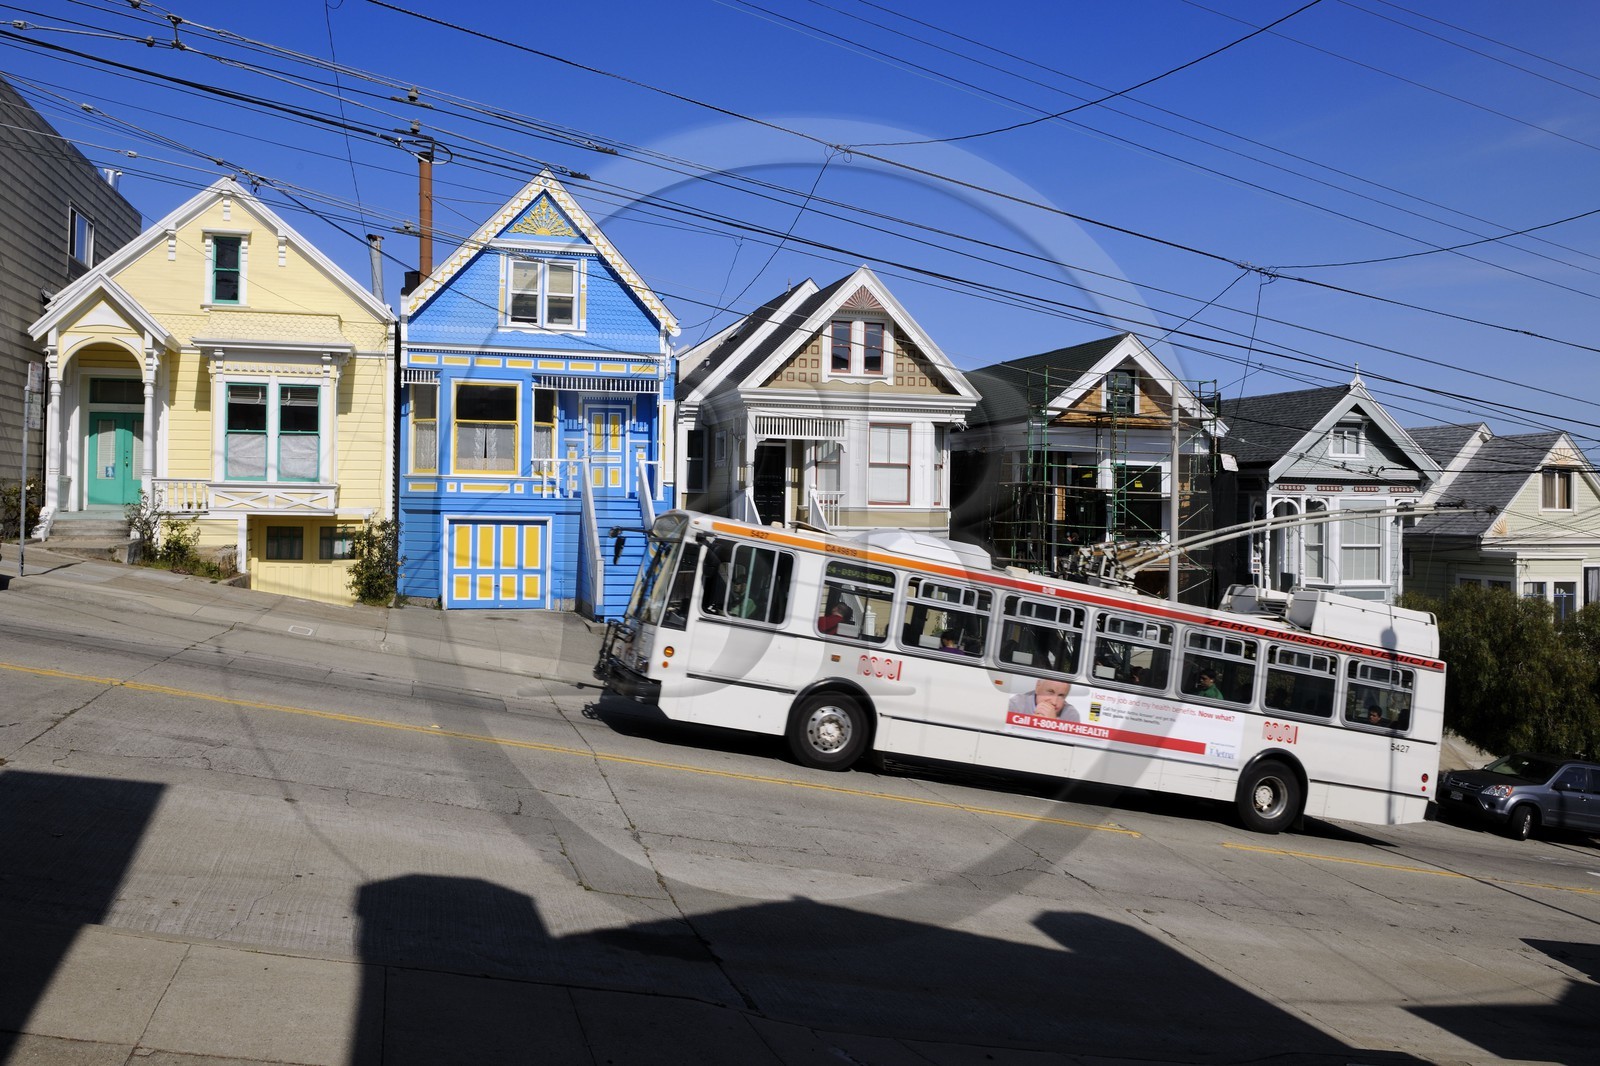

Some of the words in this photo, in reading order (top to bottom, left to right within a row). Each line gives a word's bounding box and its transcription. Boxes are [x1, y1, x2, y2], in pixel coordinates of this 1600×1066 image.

[751, 530, 769, 539] 5427
[1203, 617, 1259, 634] ZERO
[1263, 629, 1364, 654] EMISSIONS
[1368, 649, 1444, 670] VEHICLE
[1094, 692, 1106, 701] lost
[1106, 696, 1117, 704] my
[1116, 697, 1128, 705] job
[1128, 699, 1140, 707] and
[1141, 702, 1151, 710] my
[1151, 702, 1171, 712] health
[1198, 710, 1214, 719] Now
[1214, 713, 1235, 722] what?
[1012, 714, 1031, 725] Call
[1032, 718, 1110, 738] 1-800-MY-HEALTH
[1390, 742, 1410, 753] 5427
